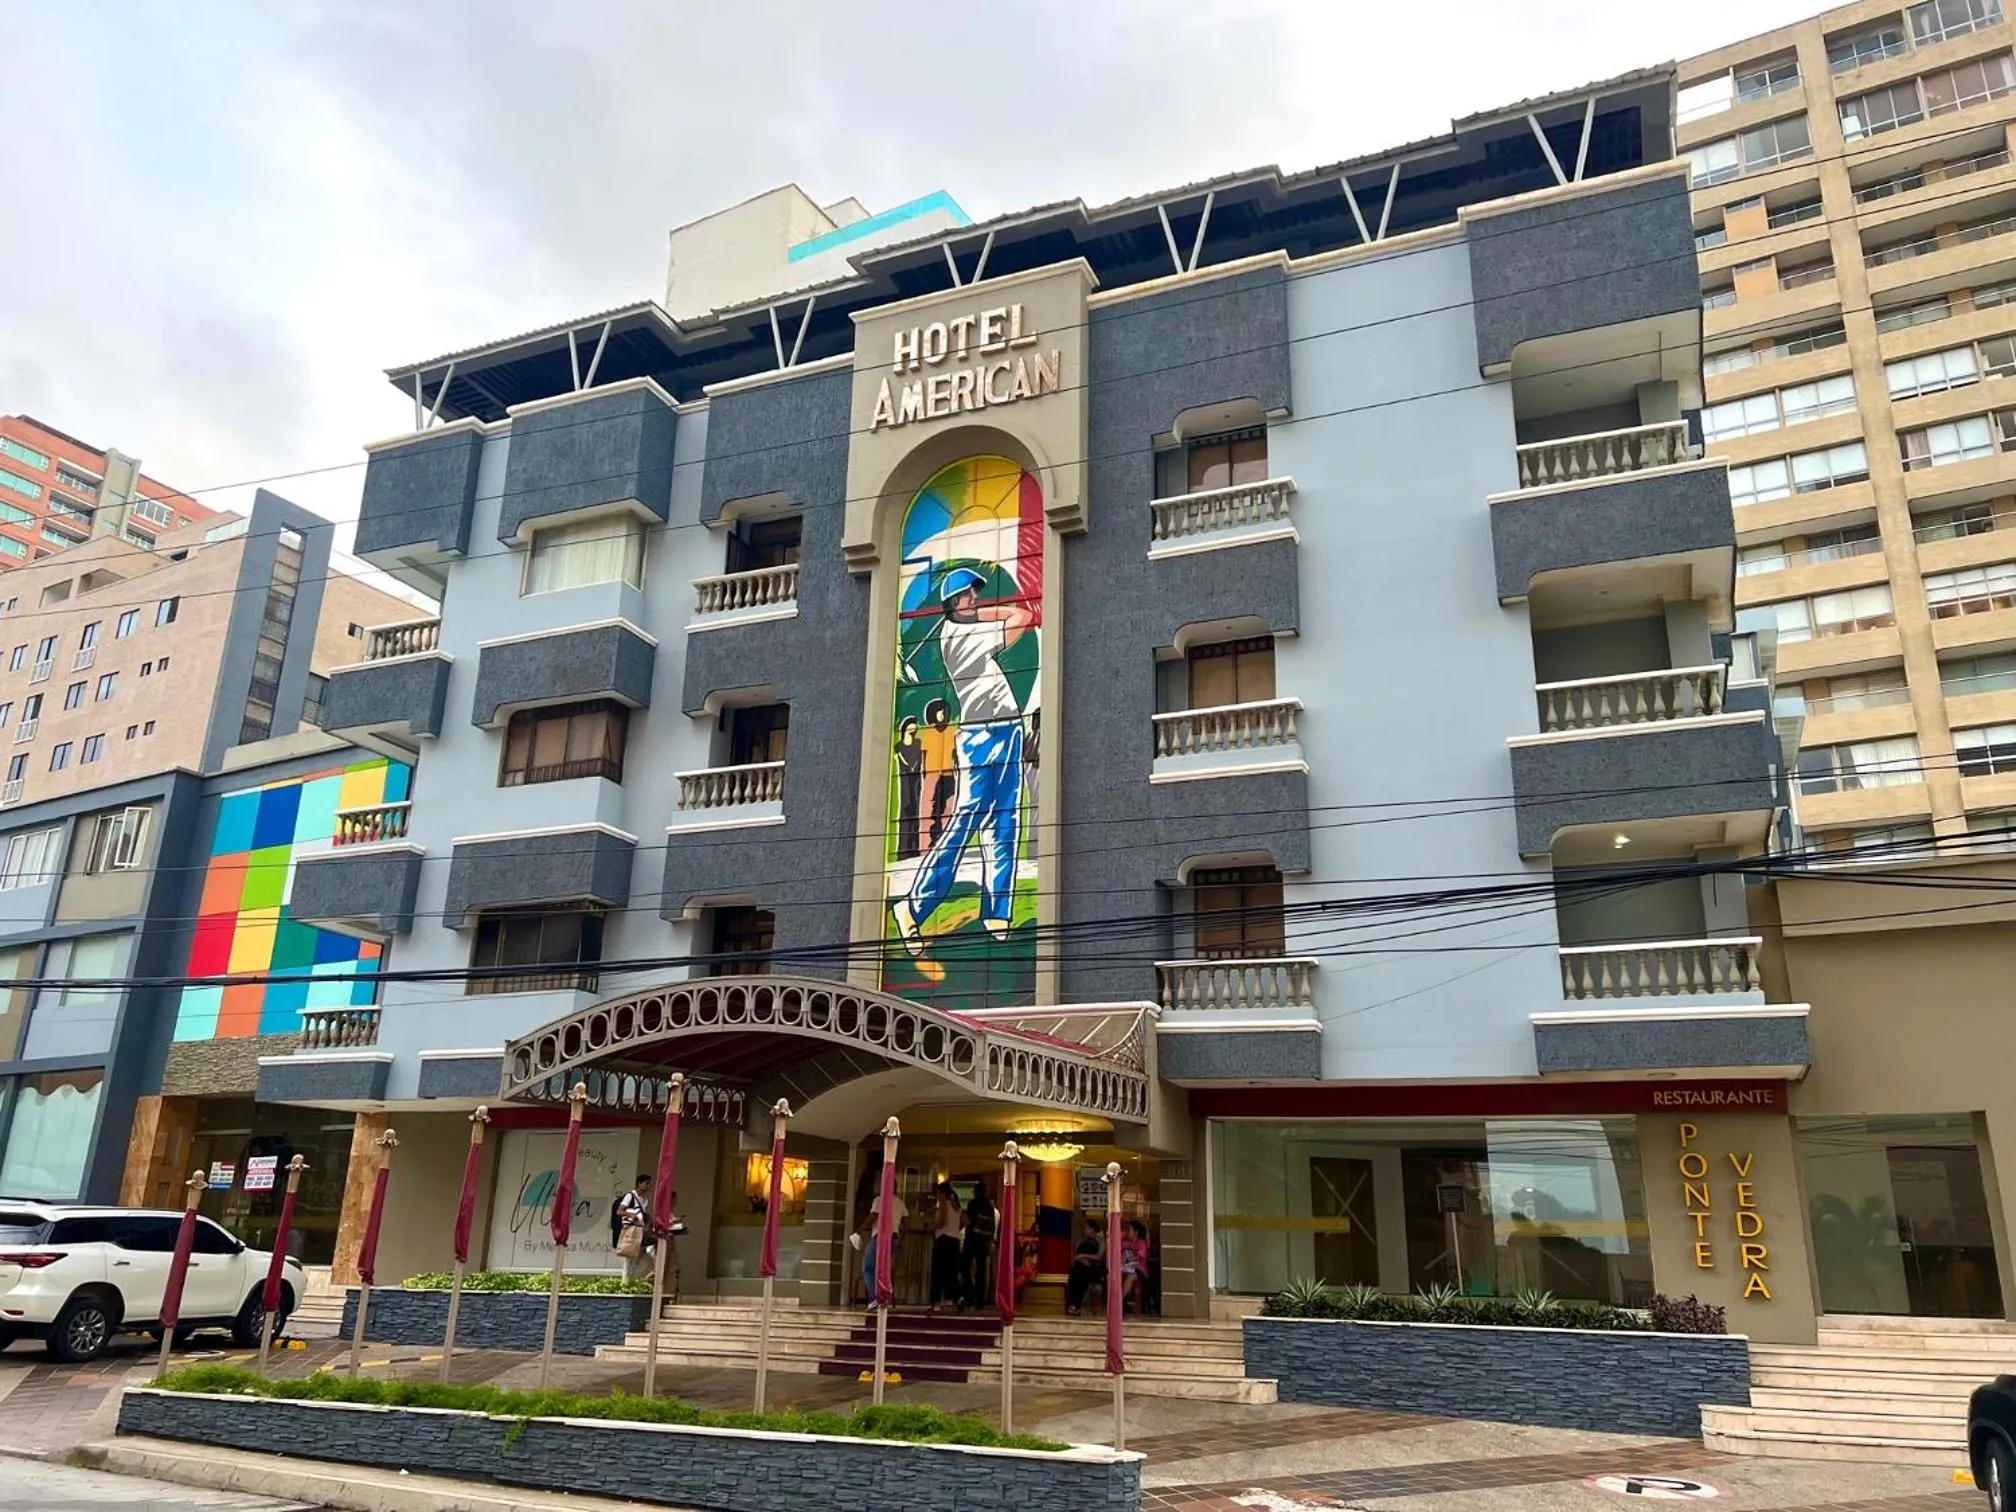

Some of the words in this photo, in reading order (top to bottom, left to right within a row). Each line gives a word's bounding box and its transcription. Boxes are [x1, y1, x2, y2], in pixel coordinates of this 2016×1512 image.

[893, 303, 1037, 375] HOTEL
[870, 349, 1061, 433] AMERICAN
[1653, 1089, 1774, 1106] RESTAURANTE
[577, 1148, 608, 1164] eauty
[1679, 1123, 1715, 1269] PONTE
[1728, 1152, 1772, 1299] VEDRA
